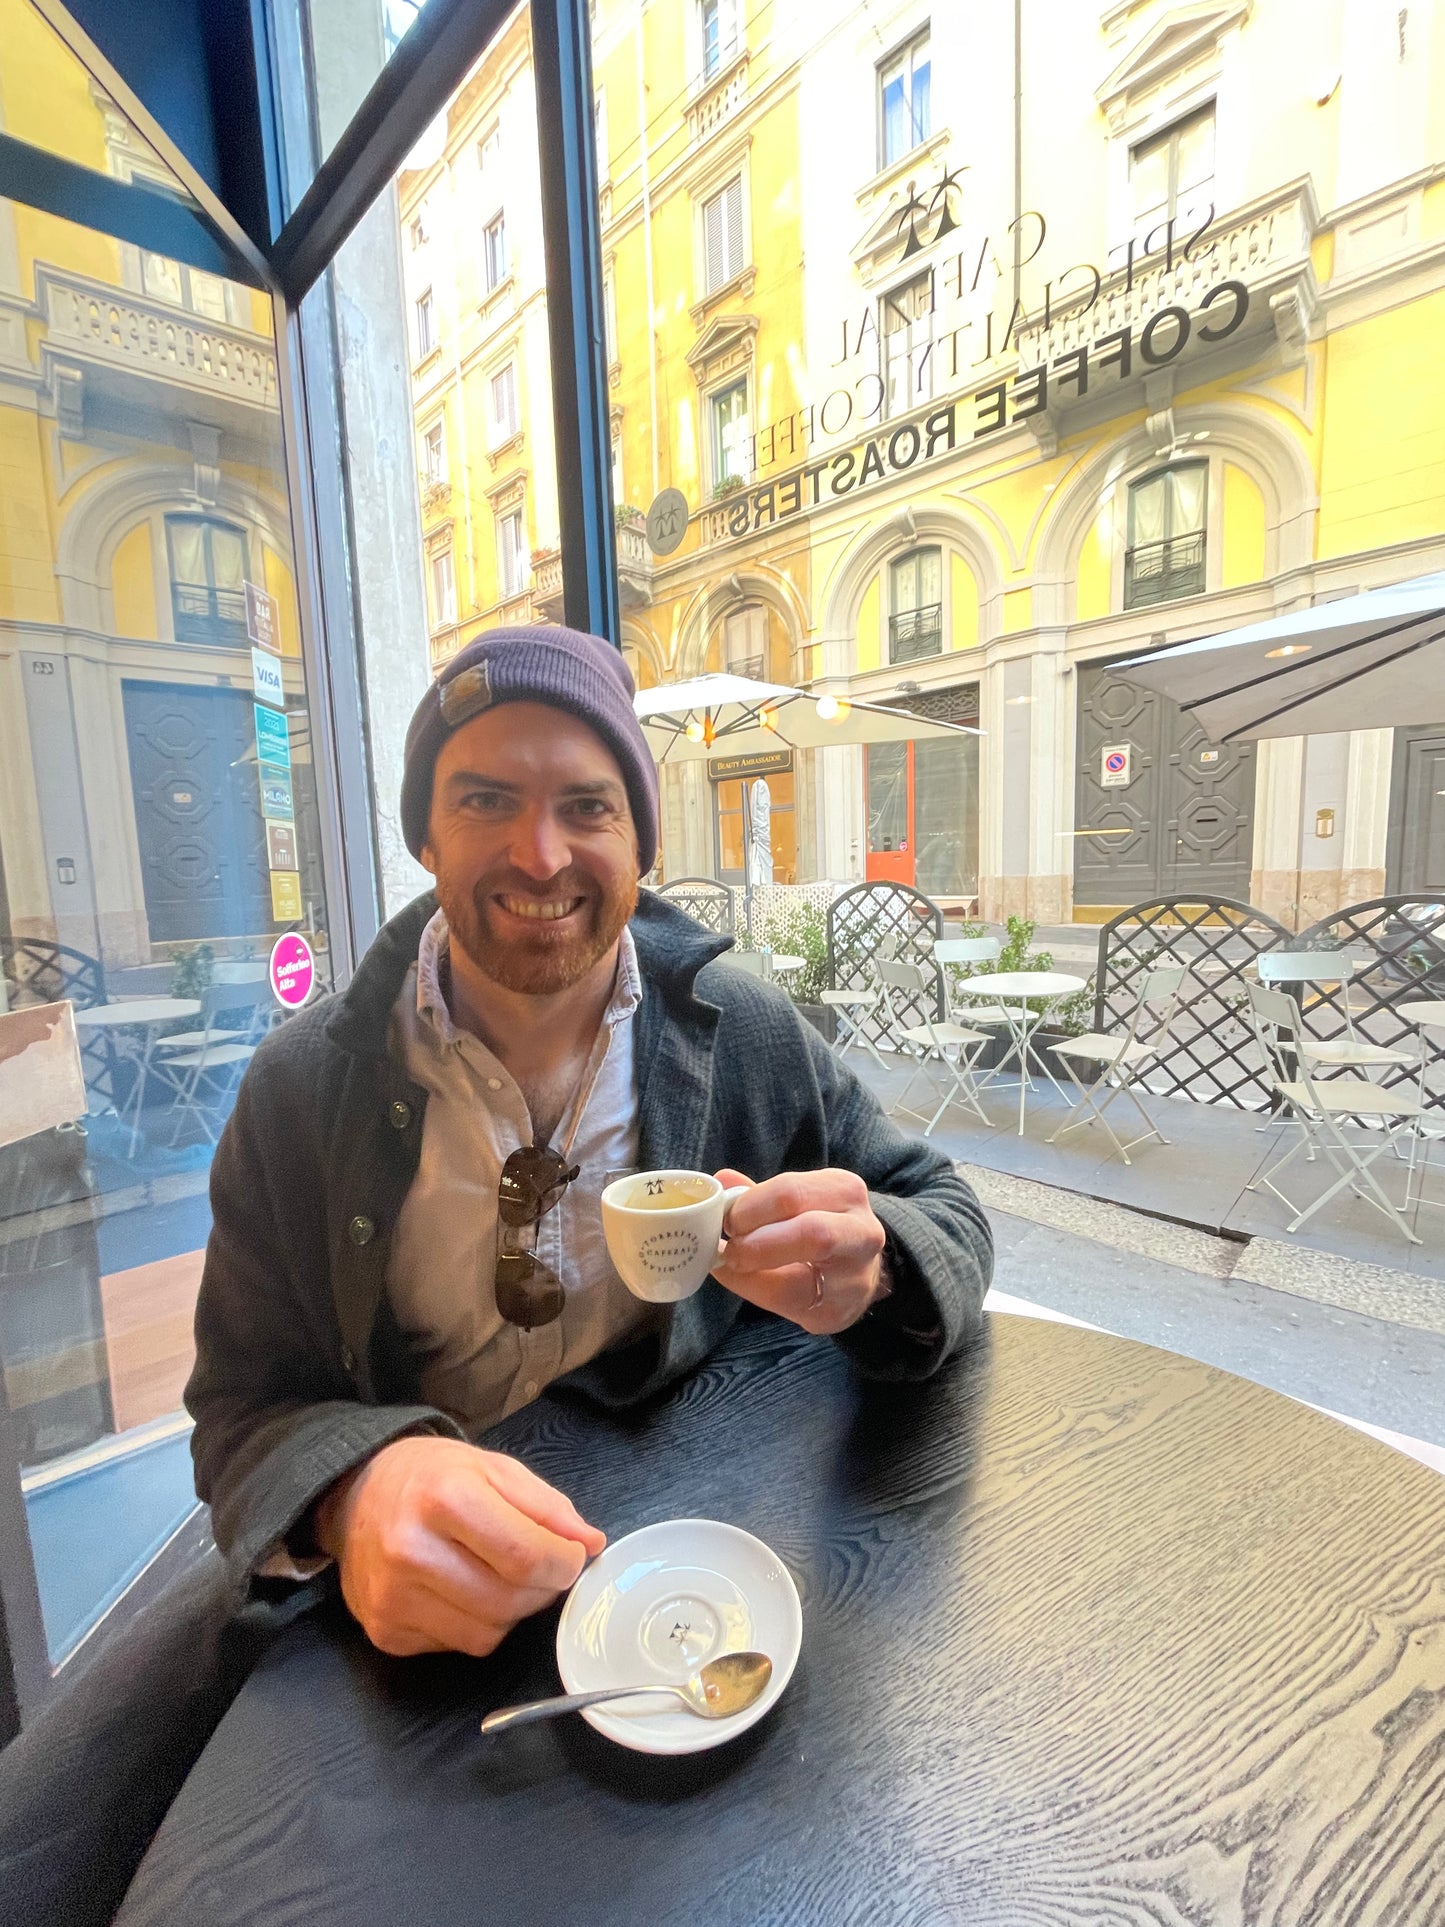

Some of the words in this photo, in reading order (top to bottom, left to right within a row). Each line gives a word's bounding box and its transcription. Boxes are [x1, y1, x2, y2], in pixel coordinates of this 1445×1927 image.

[256, 666, 280, 688] VISA
[717, 761, 740, 771] BEAUTY
[741, 754, 782, 767] AMBASSADOR
[263, 789, 291, 805] MILANO
[276, 958, 310, 978] Solferino
[279, 978, 296, 991] Alta
